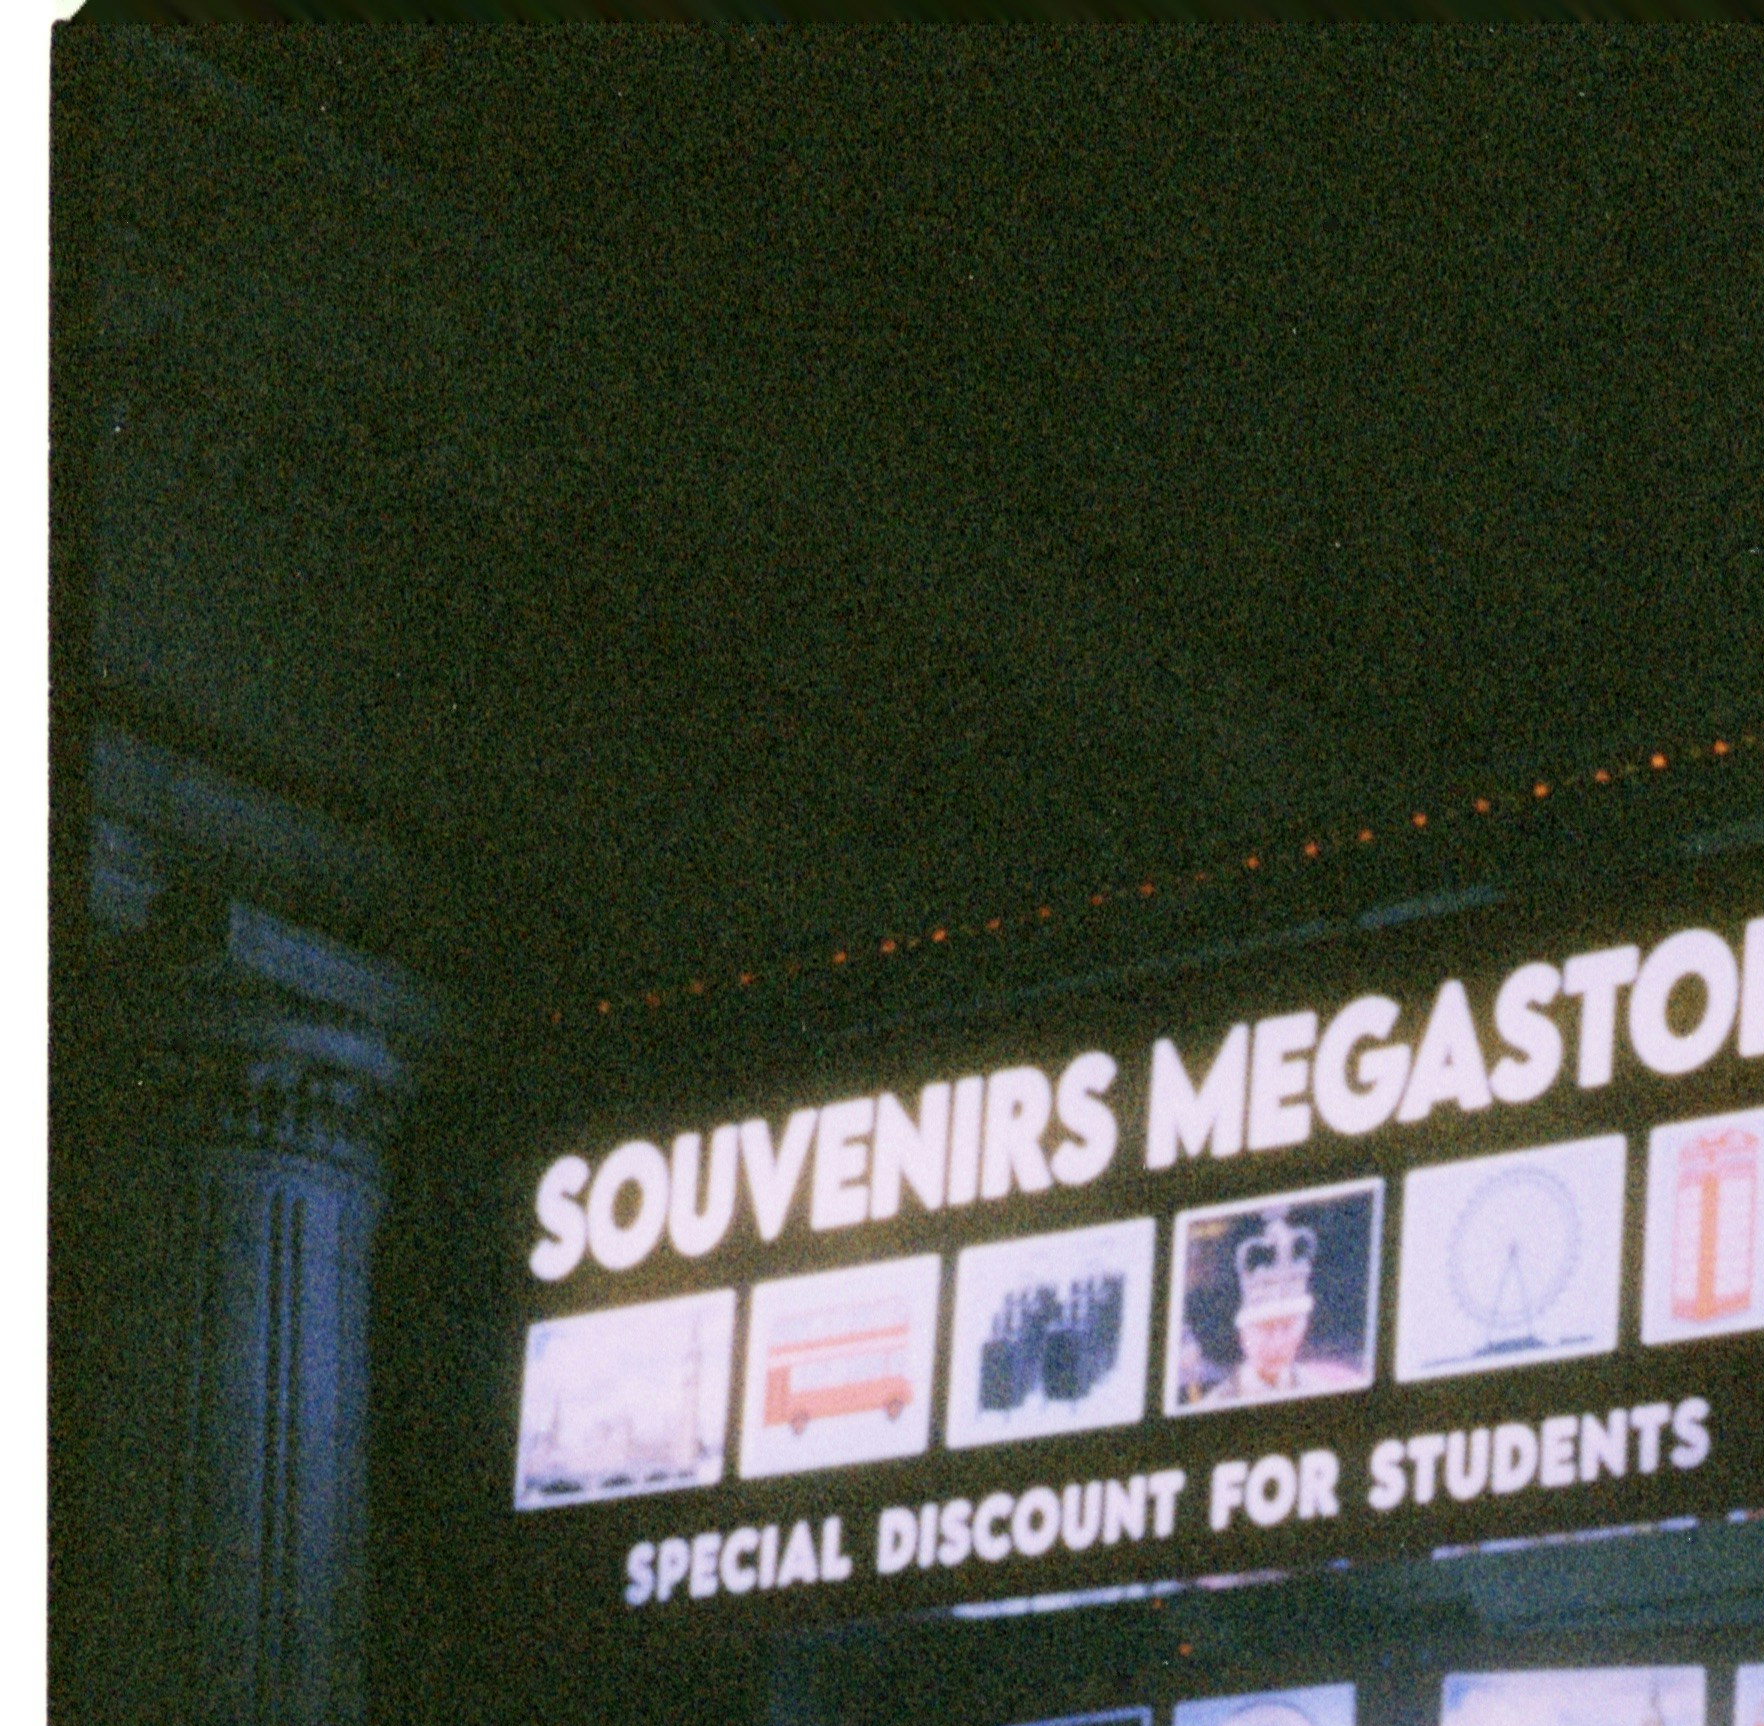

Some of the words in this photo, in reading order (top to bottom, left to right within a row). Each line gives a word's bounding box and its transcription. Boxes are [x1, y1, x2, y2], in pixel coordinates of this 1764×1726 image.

[527, 1052, 1118, 1283] SOUVENIRS
[624, 1503, 852, 1604] SPECIAL
[876, 1471, 1186, 1577] DISCOUNT
[1208, 1447, 1341, 1530] FOR
[1367, 1396, 1713, 1512] STUDENTS
